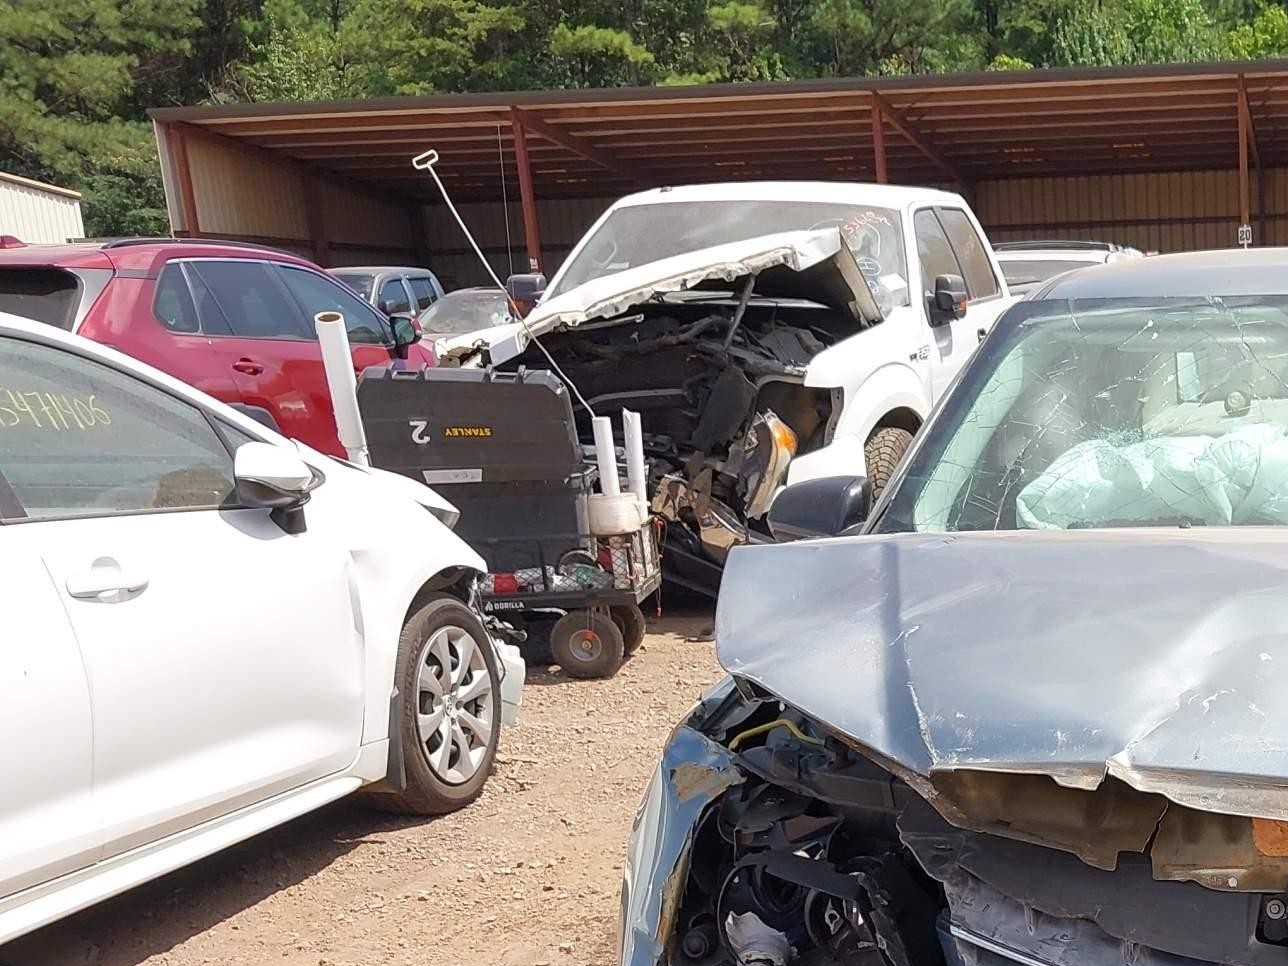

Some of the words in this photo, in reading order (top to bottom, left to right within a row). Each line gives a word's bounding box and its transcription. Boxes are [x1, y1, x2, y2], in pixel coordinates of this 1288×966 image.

[1239, 229, 1251, 241] 20
[0, 387, 112, 431] 5471406
[409, 420, 431, 444] 2
[444, 427, 492, 437] STANLEY
[493, 601, 526, 610] GORILLA
